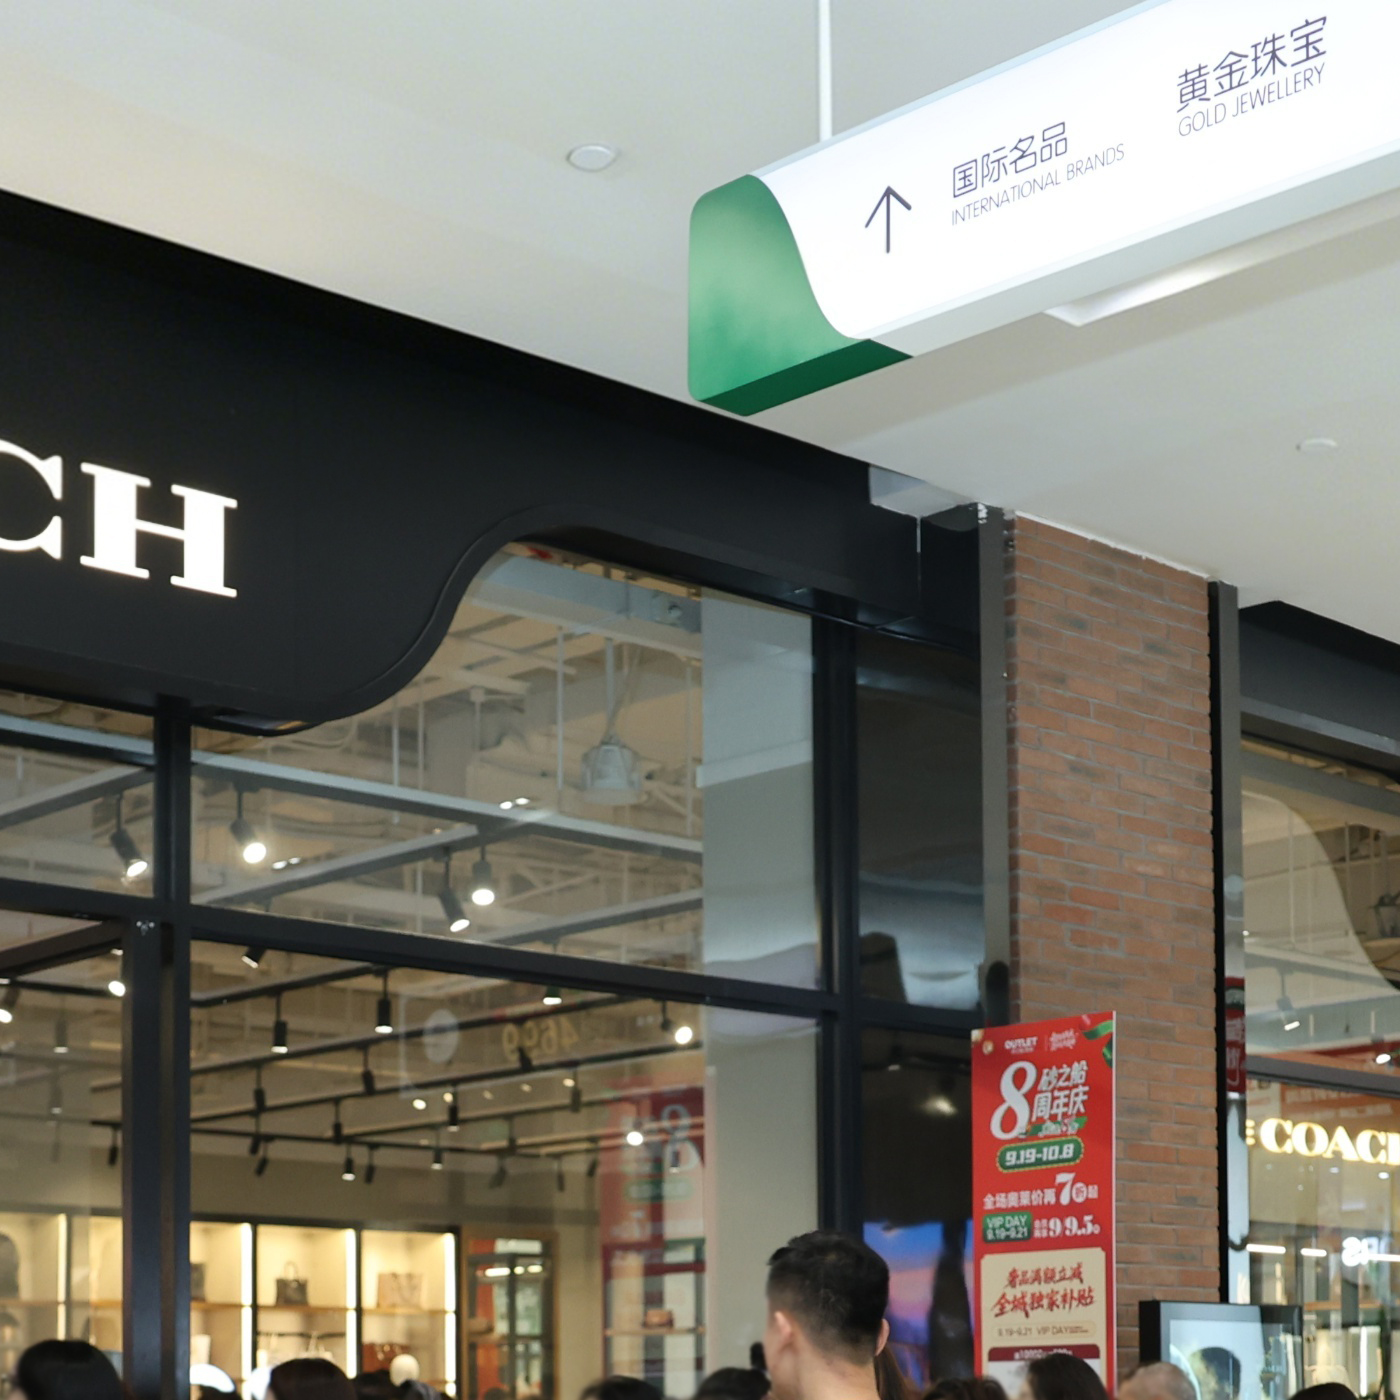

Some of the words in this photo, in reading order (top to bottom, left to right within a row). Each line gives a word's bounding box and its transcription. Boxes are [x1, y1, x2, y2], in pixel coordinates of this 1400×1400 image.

[1176, 16, 1327, 113] 黄金珠宝
[1178, 103, 1227, 137] GOLD
[1231, 62, 1326, 117] JEWELLERY
[951, 170, 1061, 226] INTERNATIONAL
[1066, 143, 1125, 181] BRANDS
[953, 122, 1068, 198] 国际名品
[990, 1060, 1038, 1141] 8
[1031, 1085, 1090, 1122] 周年庆
[1038, 1060, 1089, 1091] 砂之船
[1004, 1143, 1075, 1166] 9.19-10.8
[1005, 1215, 1028, 1227] DAY
